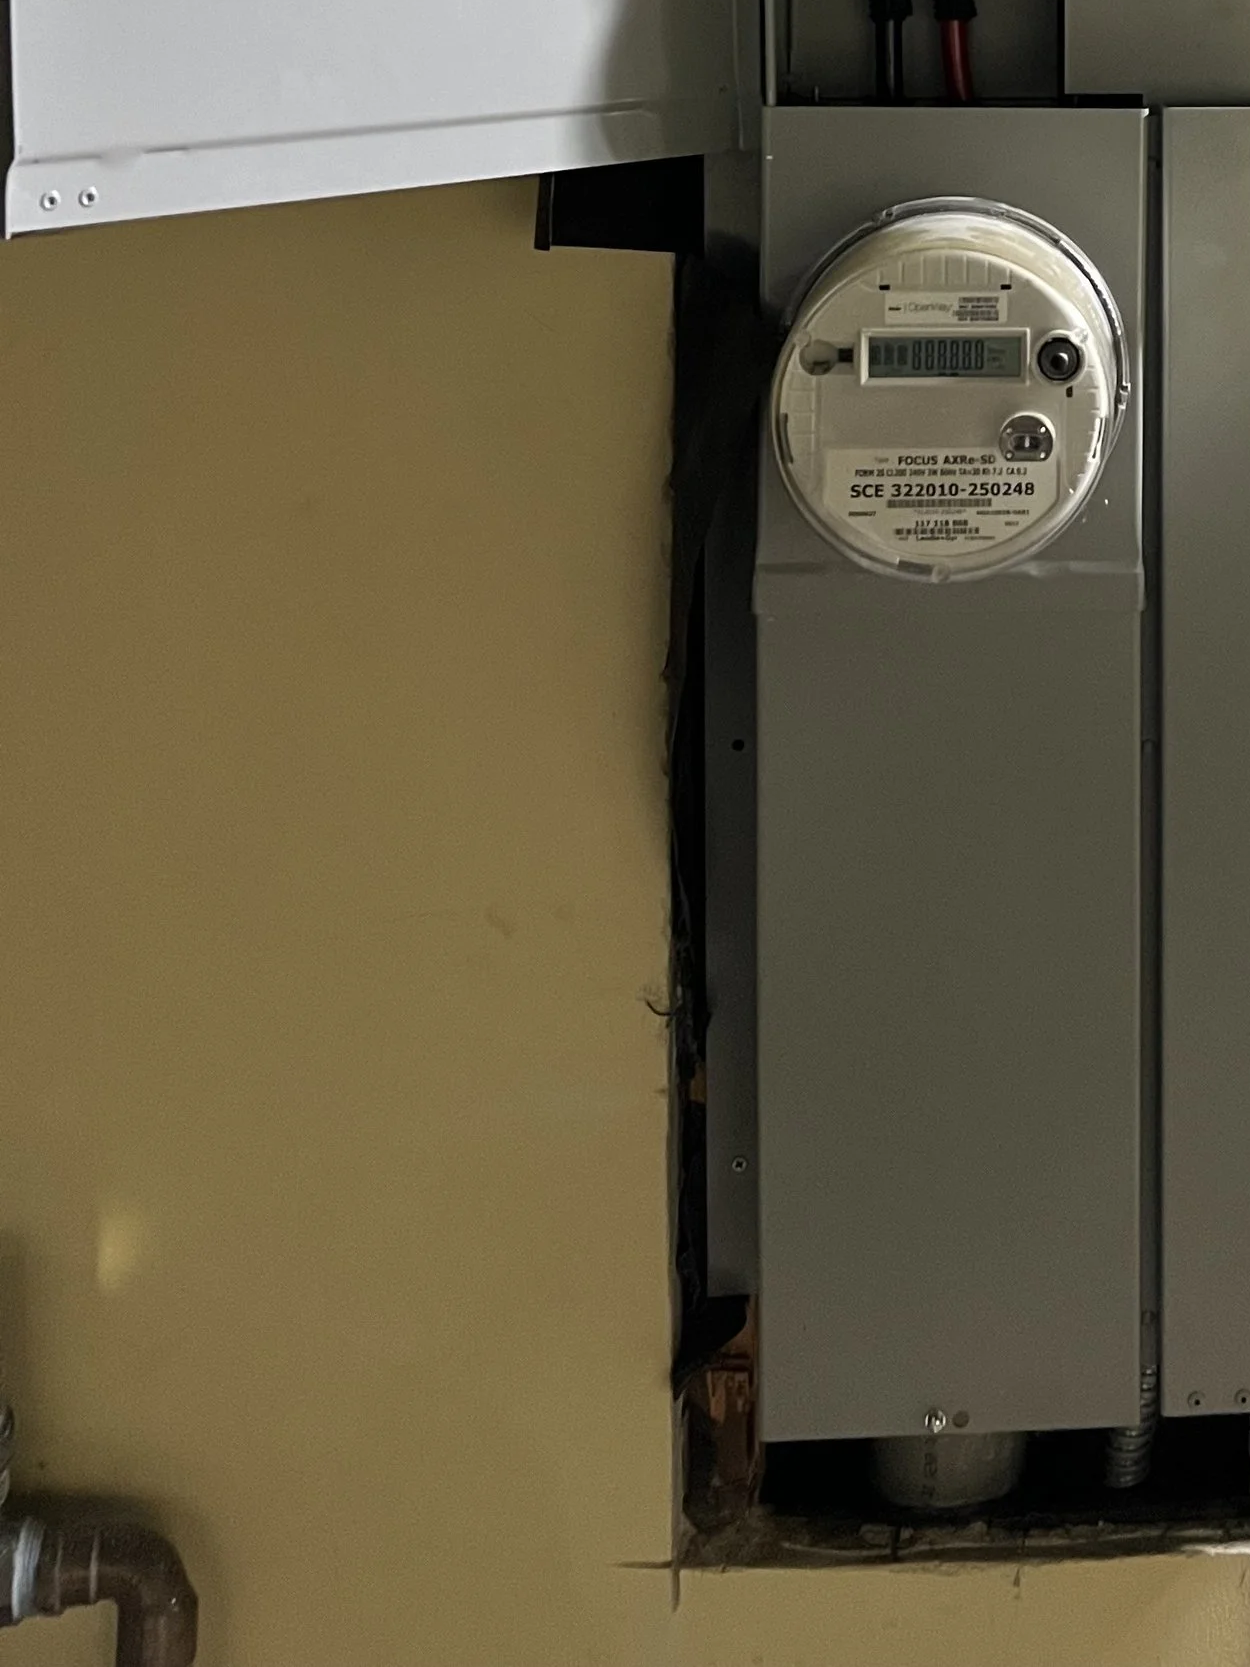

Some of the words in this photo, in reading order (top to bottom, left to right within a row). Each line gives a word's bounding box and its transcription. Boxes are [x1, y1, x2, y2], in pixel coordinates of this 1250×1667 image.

[898, 455, 938, 465] FOCUS
[943, 454, 996, 465] AXRe-SD
[850, 484, 884, 498] SCE
[891, 482, 1035, 497] 322010-250248
